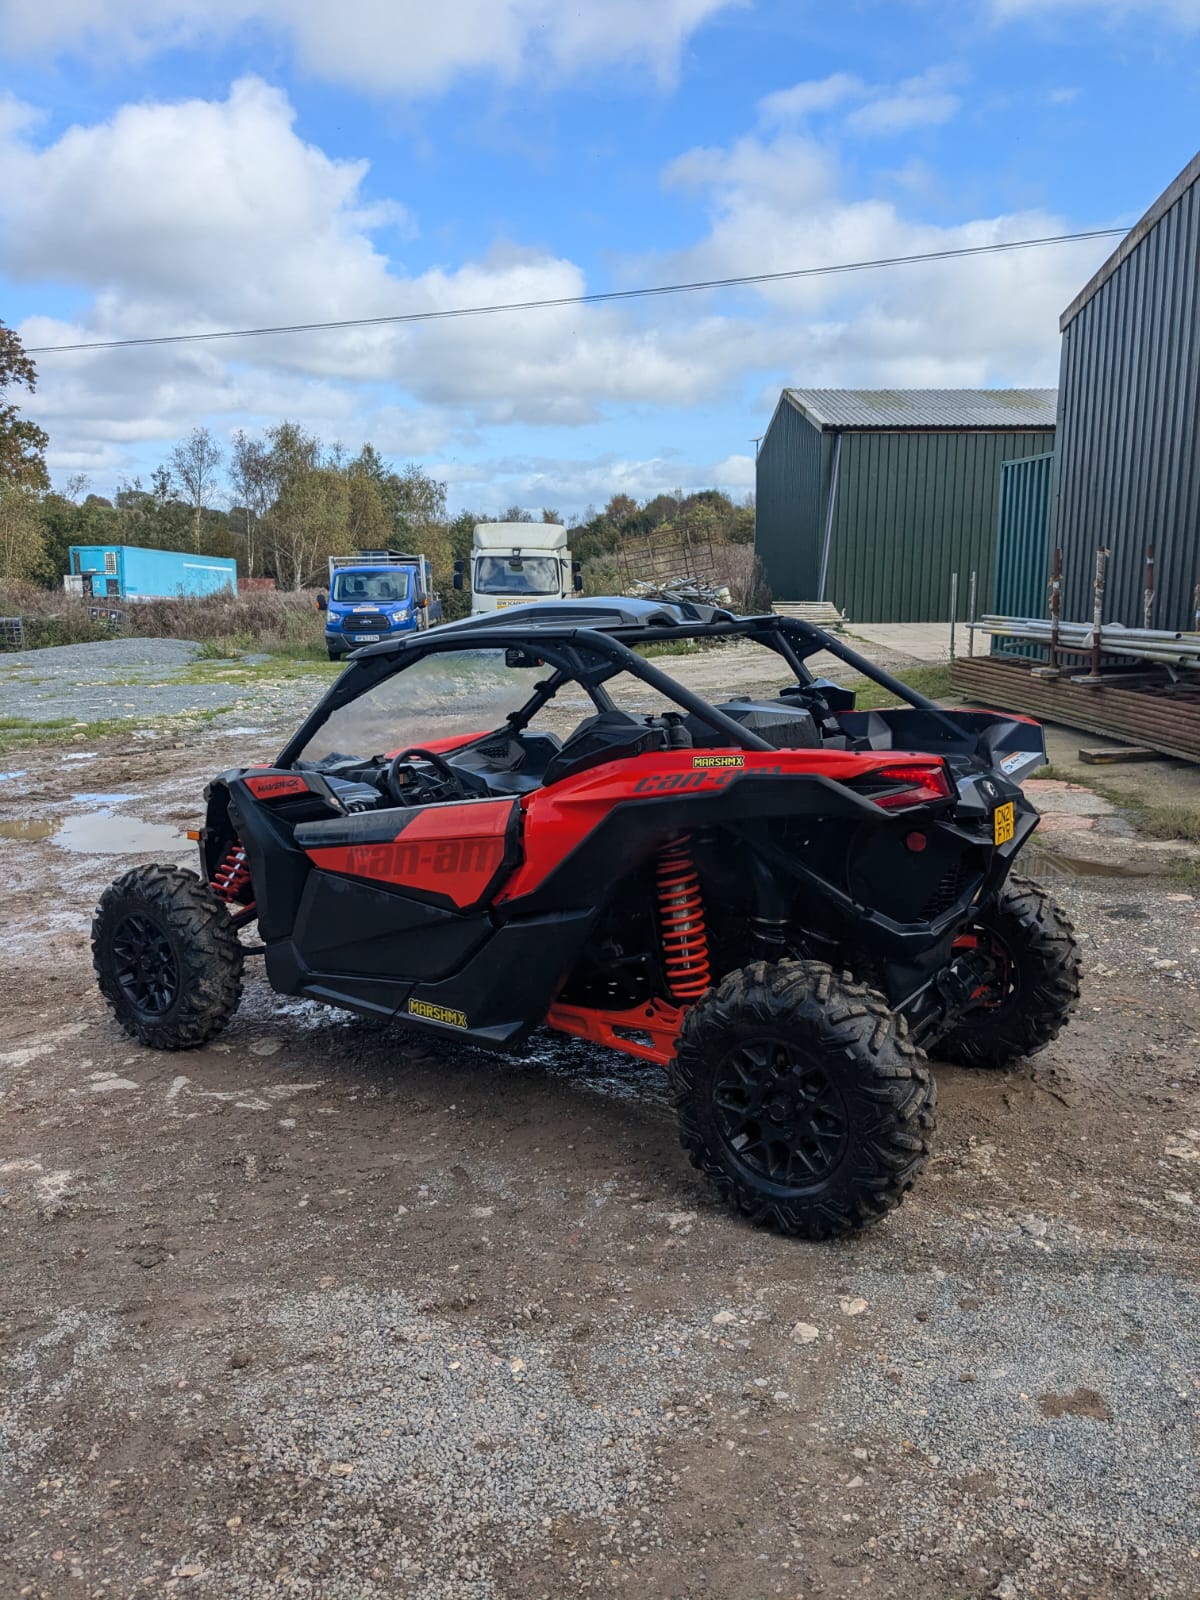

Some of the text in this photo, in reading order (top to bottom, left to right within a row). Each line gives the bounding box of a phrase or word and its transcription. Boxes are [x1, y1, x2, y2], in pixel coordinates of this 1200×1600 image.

[694, 756, 743, 767] MARSHMX
[257, 779, 299, 793] MAVERICK
[345, 841, 503, 875] can-am
[410, 1000, 465, 1027] MARSHMX
